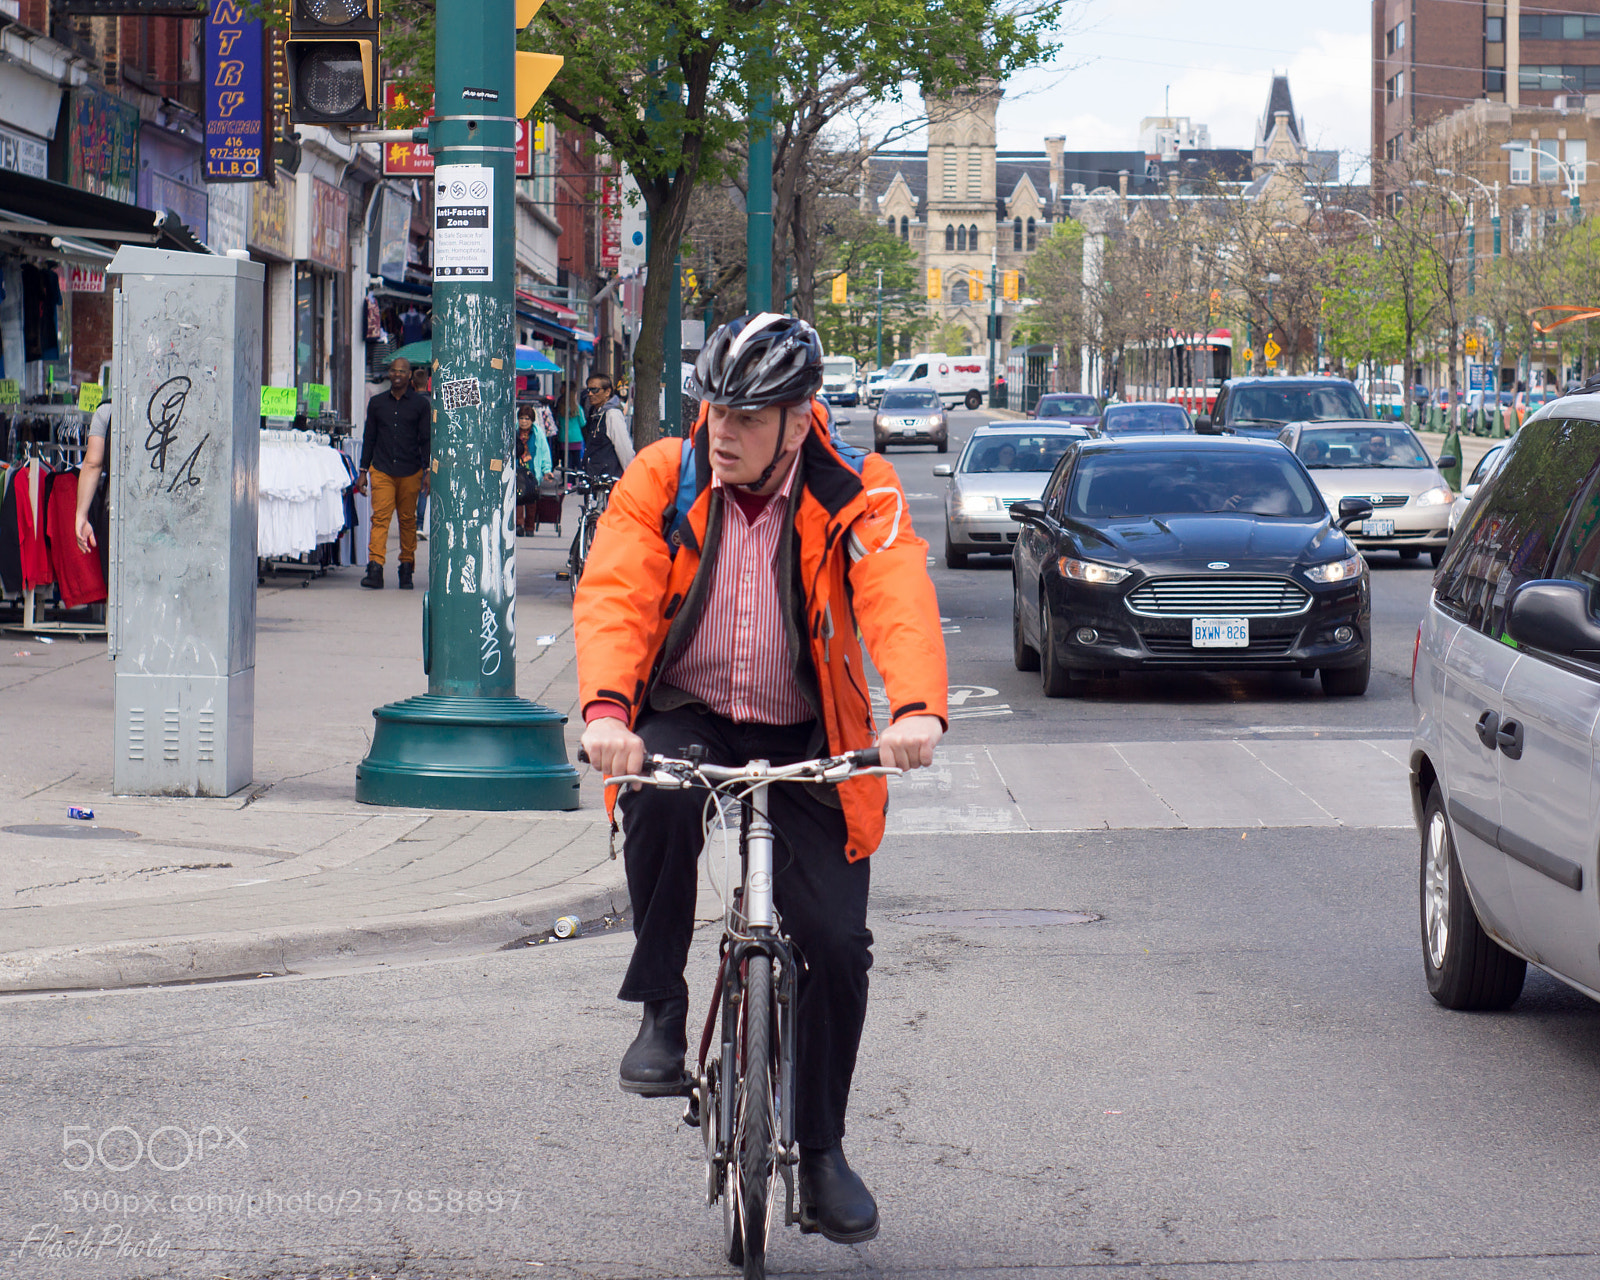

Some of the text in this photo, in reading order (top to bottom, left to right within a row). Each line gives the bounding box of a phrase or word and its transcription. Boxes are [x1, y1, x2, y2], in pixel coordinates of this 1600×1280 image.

[207, 120, 261, 134] KITCHEN
[225, 136, 243, 147] 416
[209, 147, 261, 159] 977-5999
[413, 144, 429, 157] 41
[437, 208, 486, 217] Anti-Fascist
[446, 218, 469, 227] Zone
[1195, 625, 1246, 640] BXWN 826
